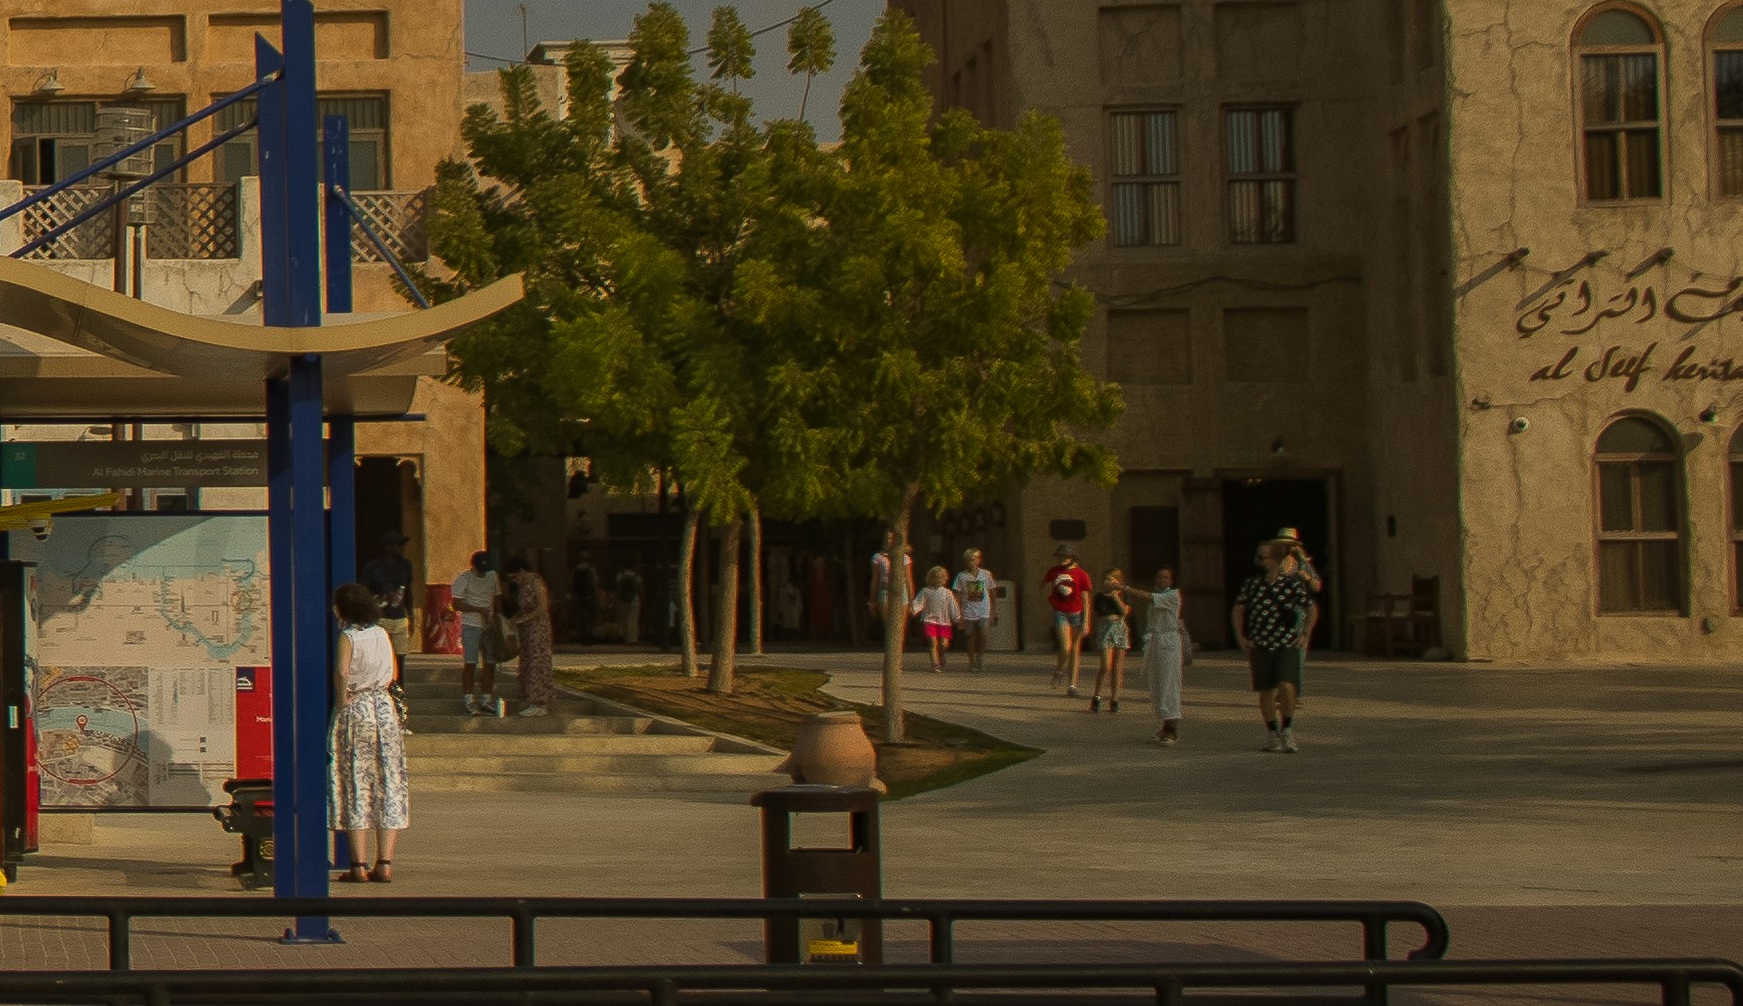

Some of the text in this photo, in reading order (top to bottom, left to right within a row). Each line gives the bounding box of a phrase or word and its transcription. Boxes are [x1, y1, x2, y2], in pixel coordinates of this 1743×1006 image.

[1530, 346, 1579, 381] al
[92, 465, 259, 477] Al Fahidi Marine Transport Station
